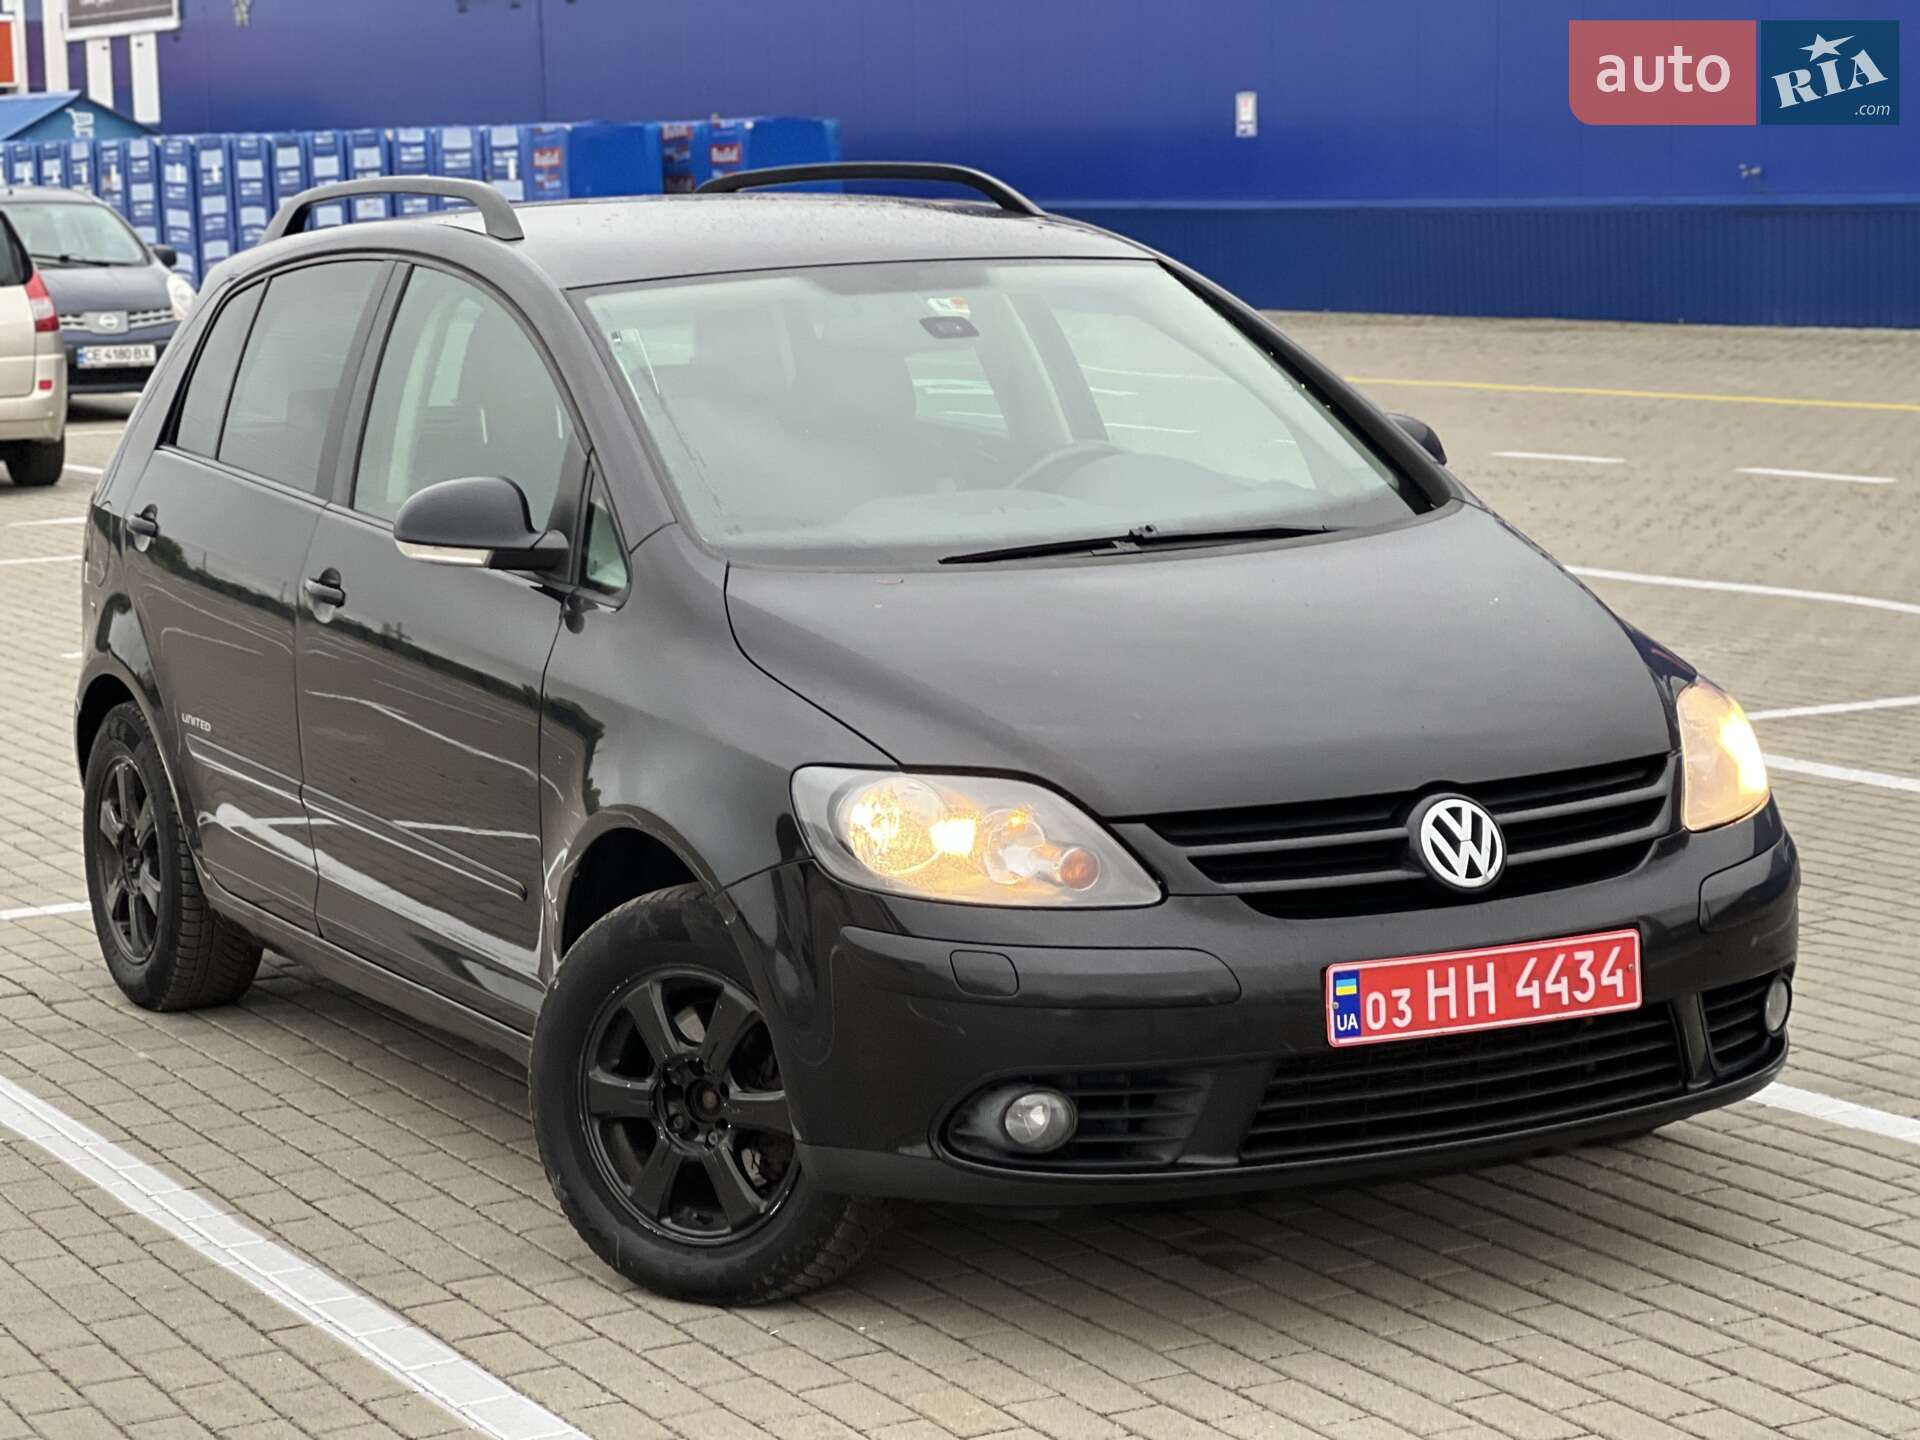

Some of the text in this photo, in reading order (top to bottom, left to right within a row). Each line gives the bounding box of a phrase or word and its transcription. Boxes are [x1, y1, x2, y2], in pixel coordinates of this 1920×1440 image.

[1365, 988, 1413, 1030] 03
[1515, 946, 1624, 1009] 4434
[1336, 1012, 1359, 1031] UA
